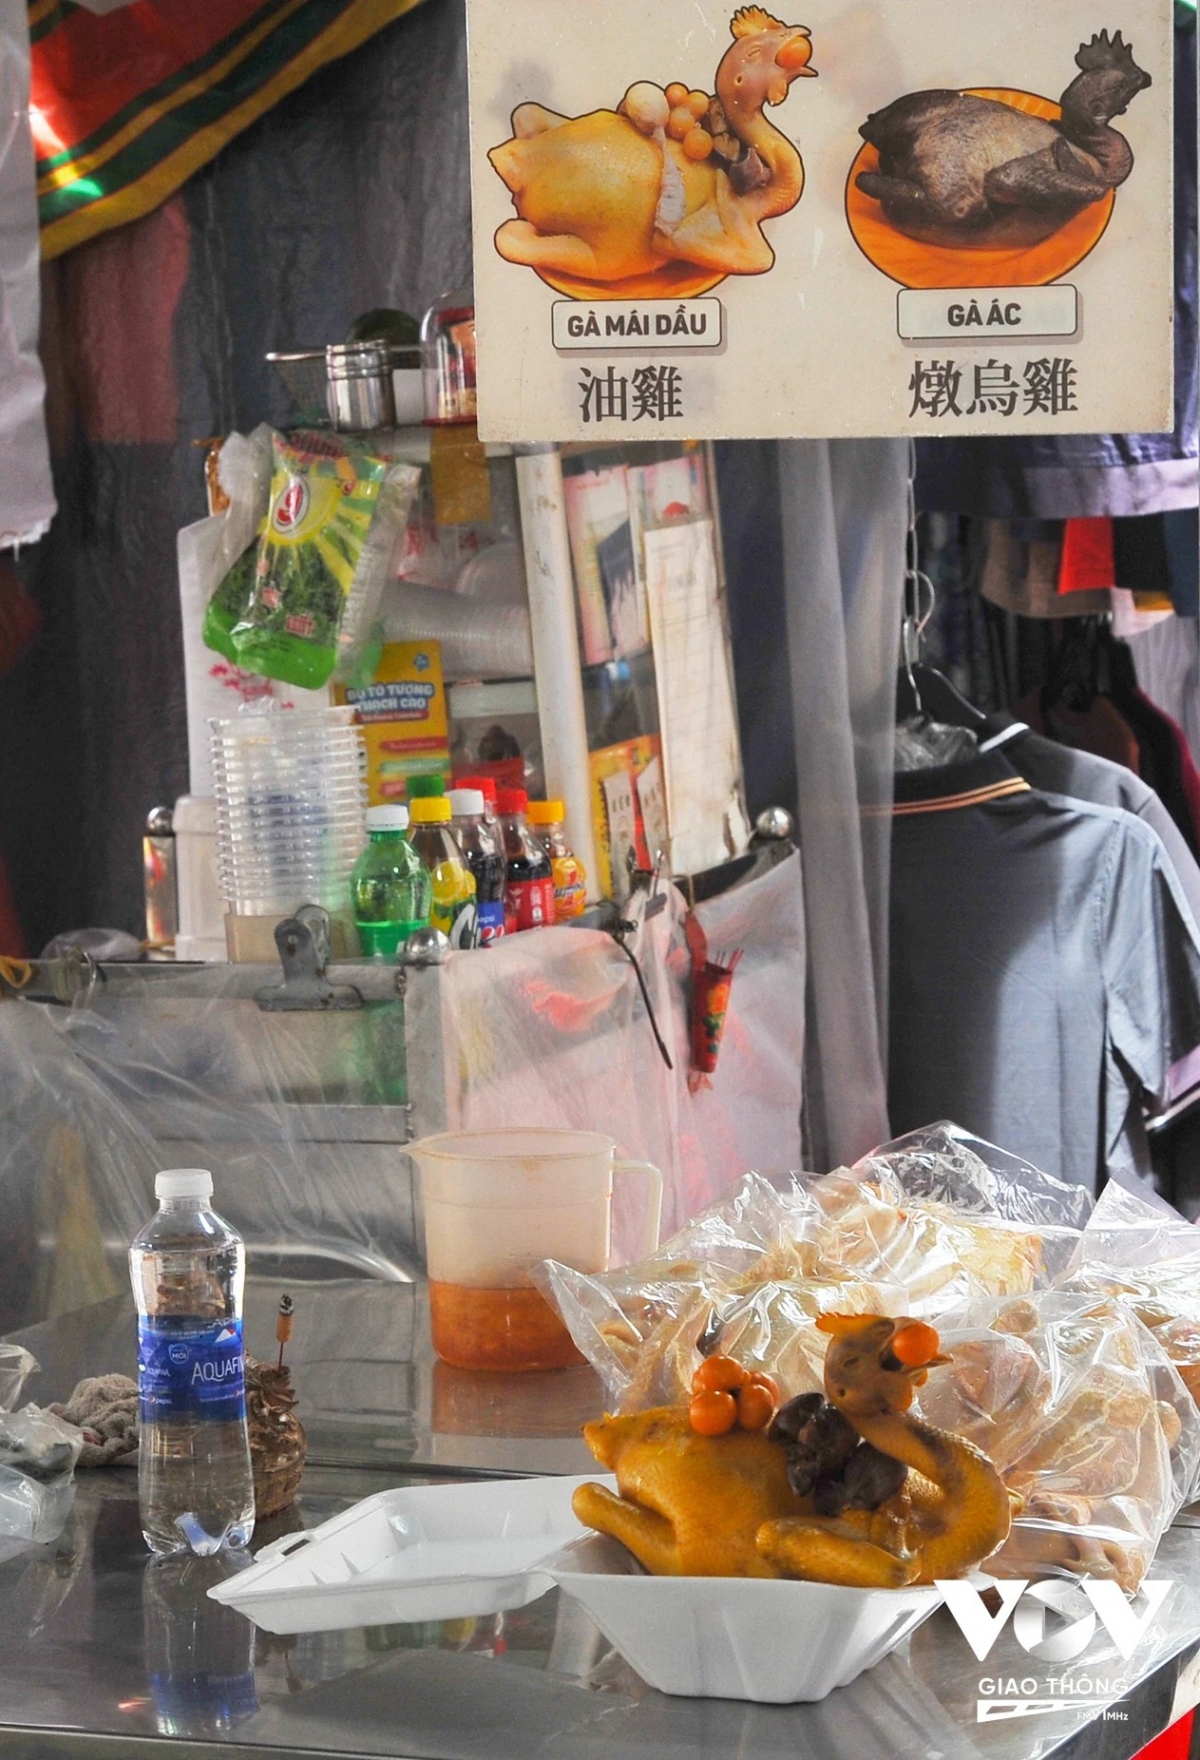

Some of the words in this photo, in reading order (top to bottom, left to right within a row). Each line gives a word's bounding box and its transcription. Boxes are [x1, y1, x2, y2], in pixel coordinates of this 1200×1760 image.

[567, 310, 600, 337] GÀ
[605, 309, 650, 337] MÁI
[655, 304, 706, 335] DẦU
[947, 299, 983, 327] GÀ
[986, 298, 1021, 325] ÁC
[578, 365, 684, 422] 油雞
[908, 357, 1078, 418] 燉烏雞
